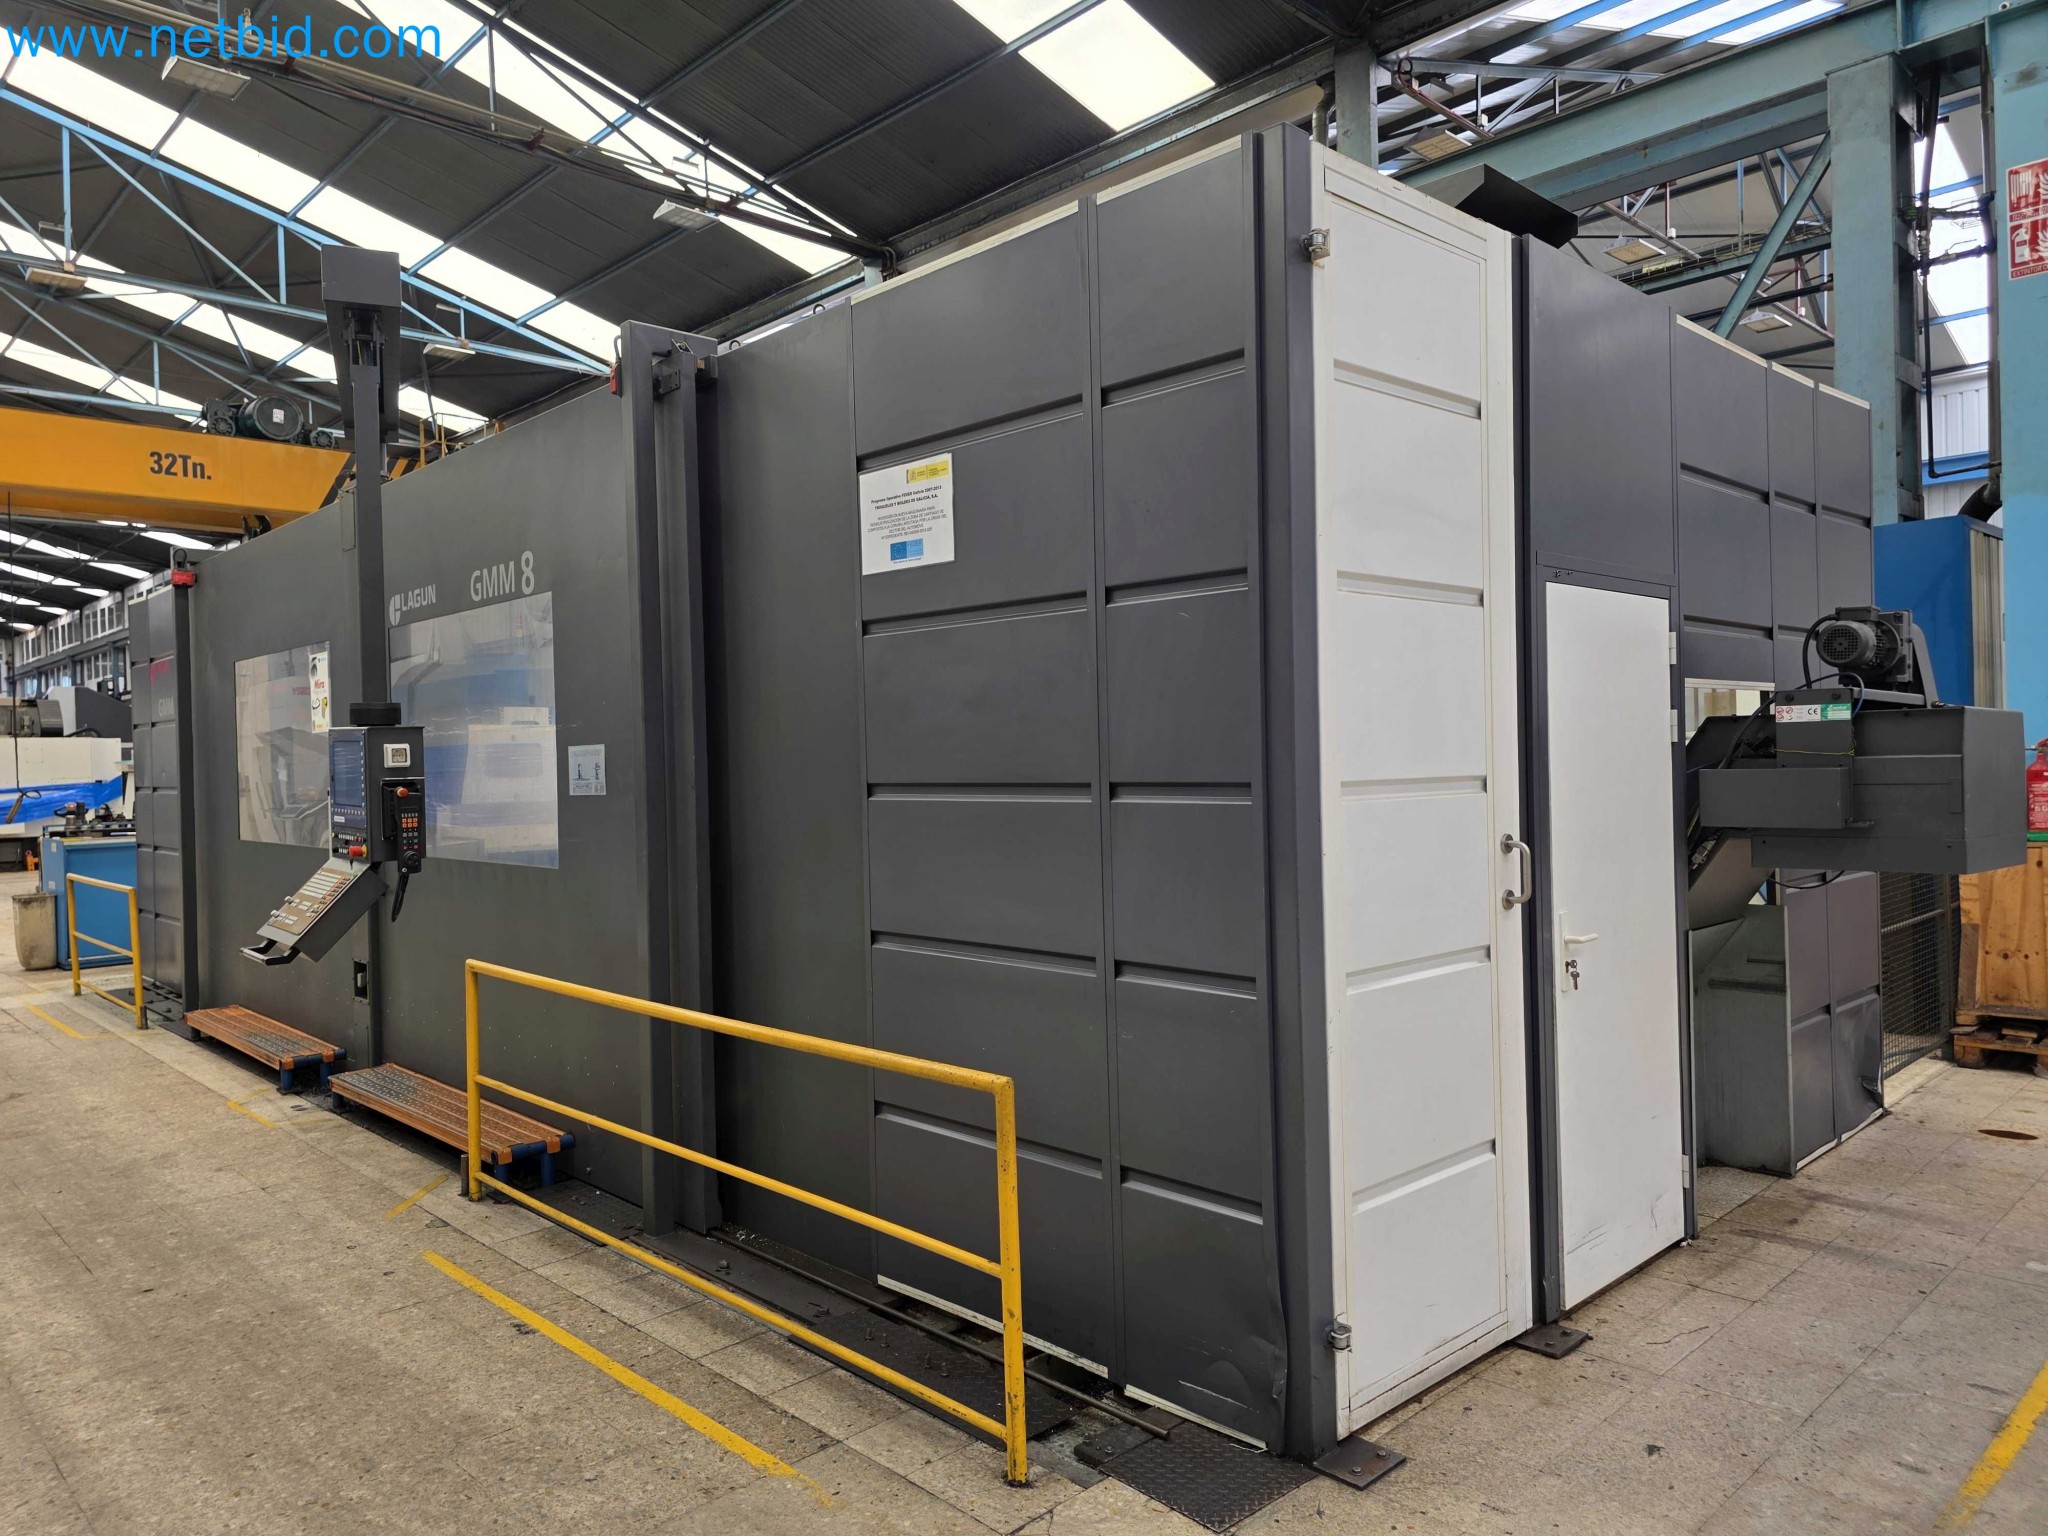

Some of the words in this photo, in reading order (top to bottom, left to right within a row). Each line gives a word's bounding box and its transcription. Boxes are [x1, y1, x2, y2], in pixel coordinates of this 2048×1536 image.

[149, 451, 212, 480] 32Tn.
[470, 560, 516, 601] GMM
[521, 550, 535, 594] 8
[401, 584, 437, 611] LAGUN
